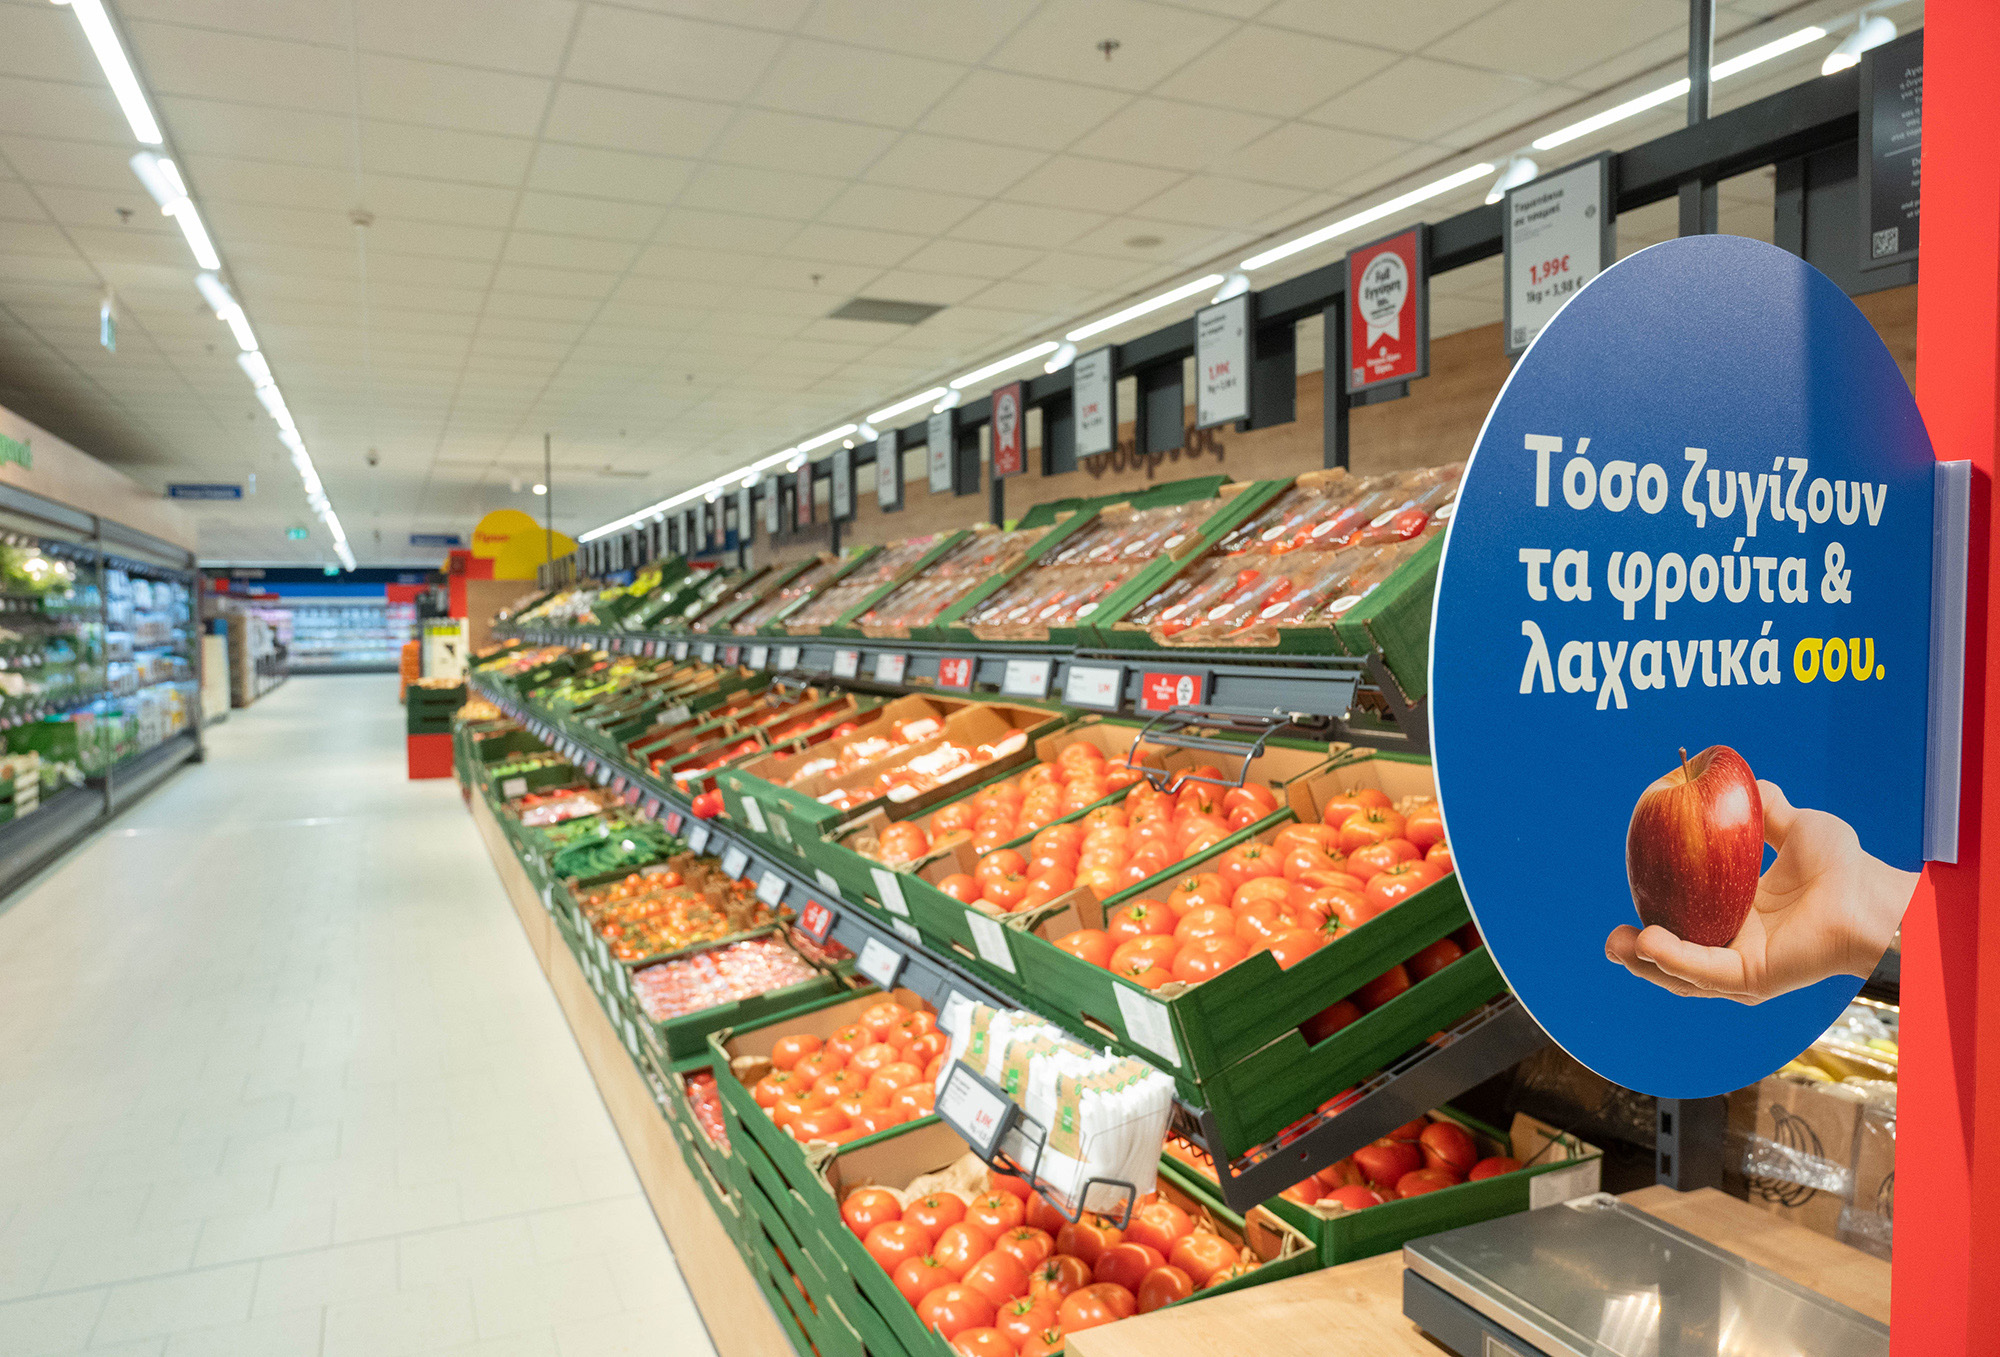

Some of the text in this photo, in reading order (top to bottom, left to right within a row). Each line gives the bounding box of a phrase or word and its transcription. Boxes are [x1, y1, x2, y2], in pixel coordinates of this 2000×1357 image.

[1529, 254, 1570, 286] 1,99€
[1525, 433, 1887, 537] Τόσο ζυγίζουν
[1519, 537, 1852, 621] τα φρούτα &
[1519, 619, 1885, 710] λαχανικά σου.
